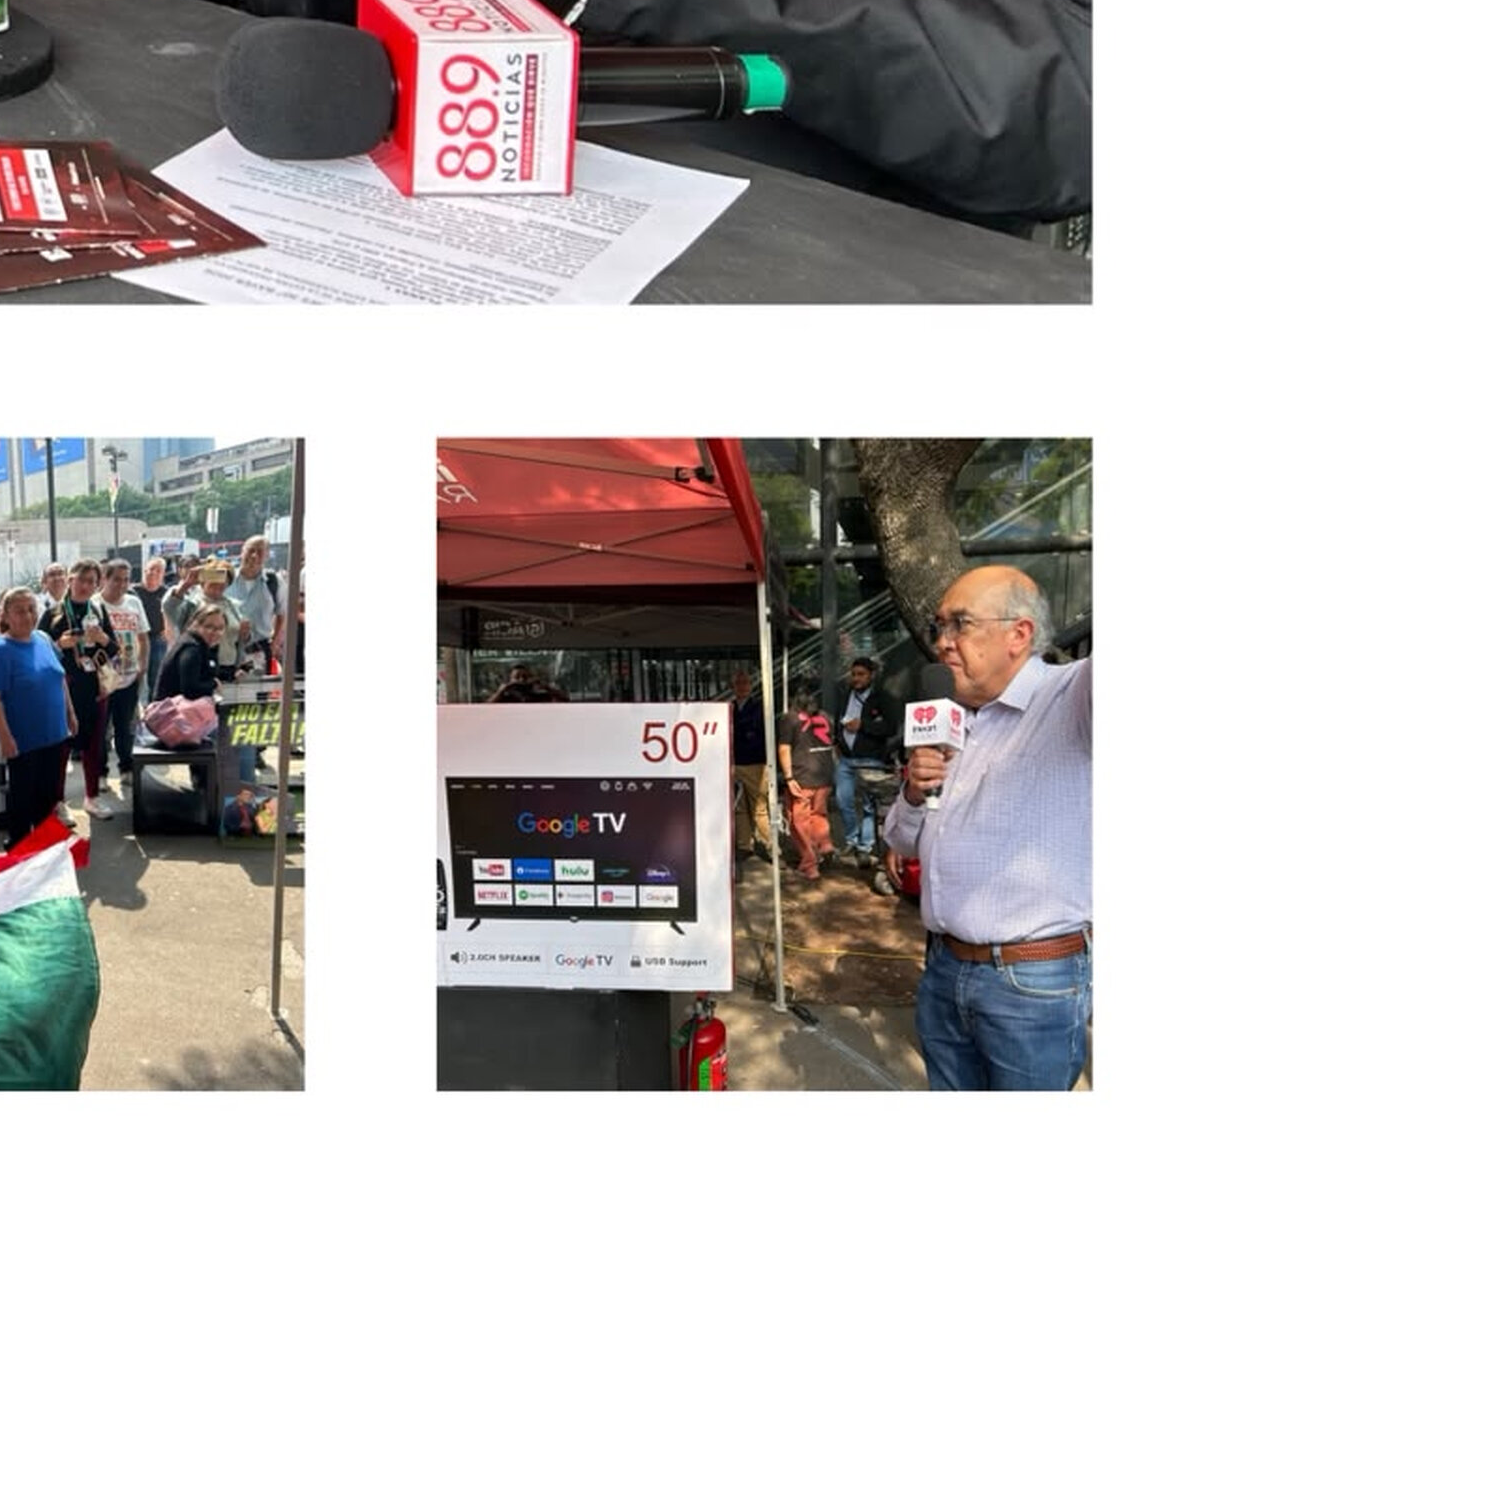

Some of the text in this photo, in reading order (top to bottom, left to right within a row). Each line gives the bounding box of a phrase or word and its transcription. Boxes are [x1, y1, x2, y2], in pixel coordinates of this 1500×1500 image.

[436, 53, 501, 181] 88.9
[500, 53, 522, 183] NOTICIAS
[517, 811, 626, 839] Google TV
[561, 864, 590, 877] hulu
[477, 891, 508, 900] NETFLIX
[498, 953, 542, 963] SPEAKER
[555, 953, 613, 970] Google TV
[669, 957, 708, 969] Support
